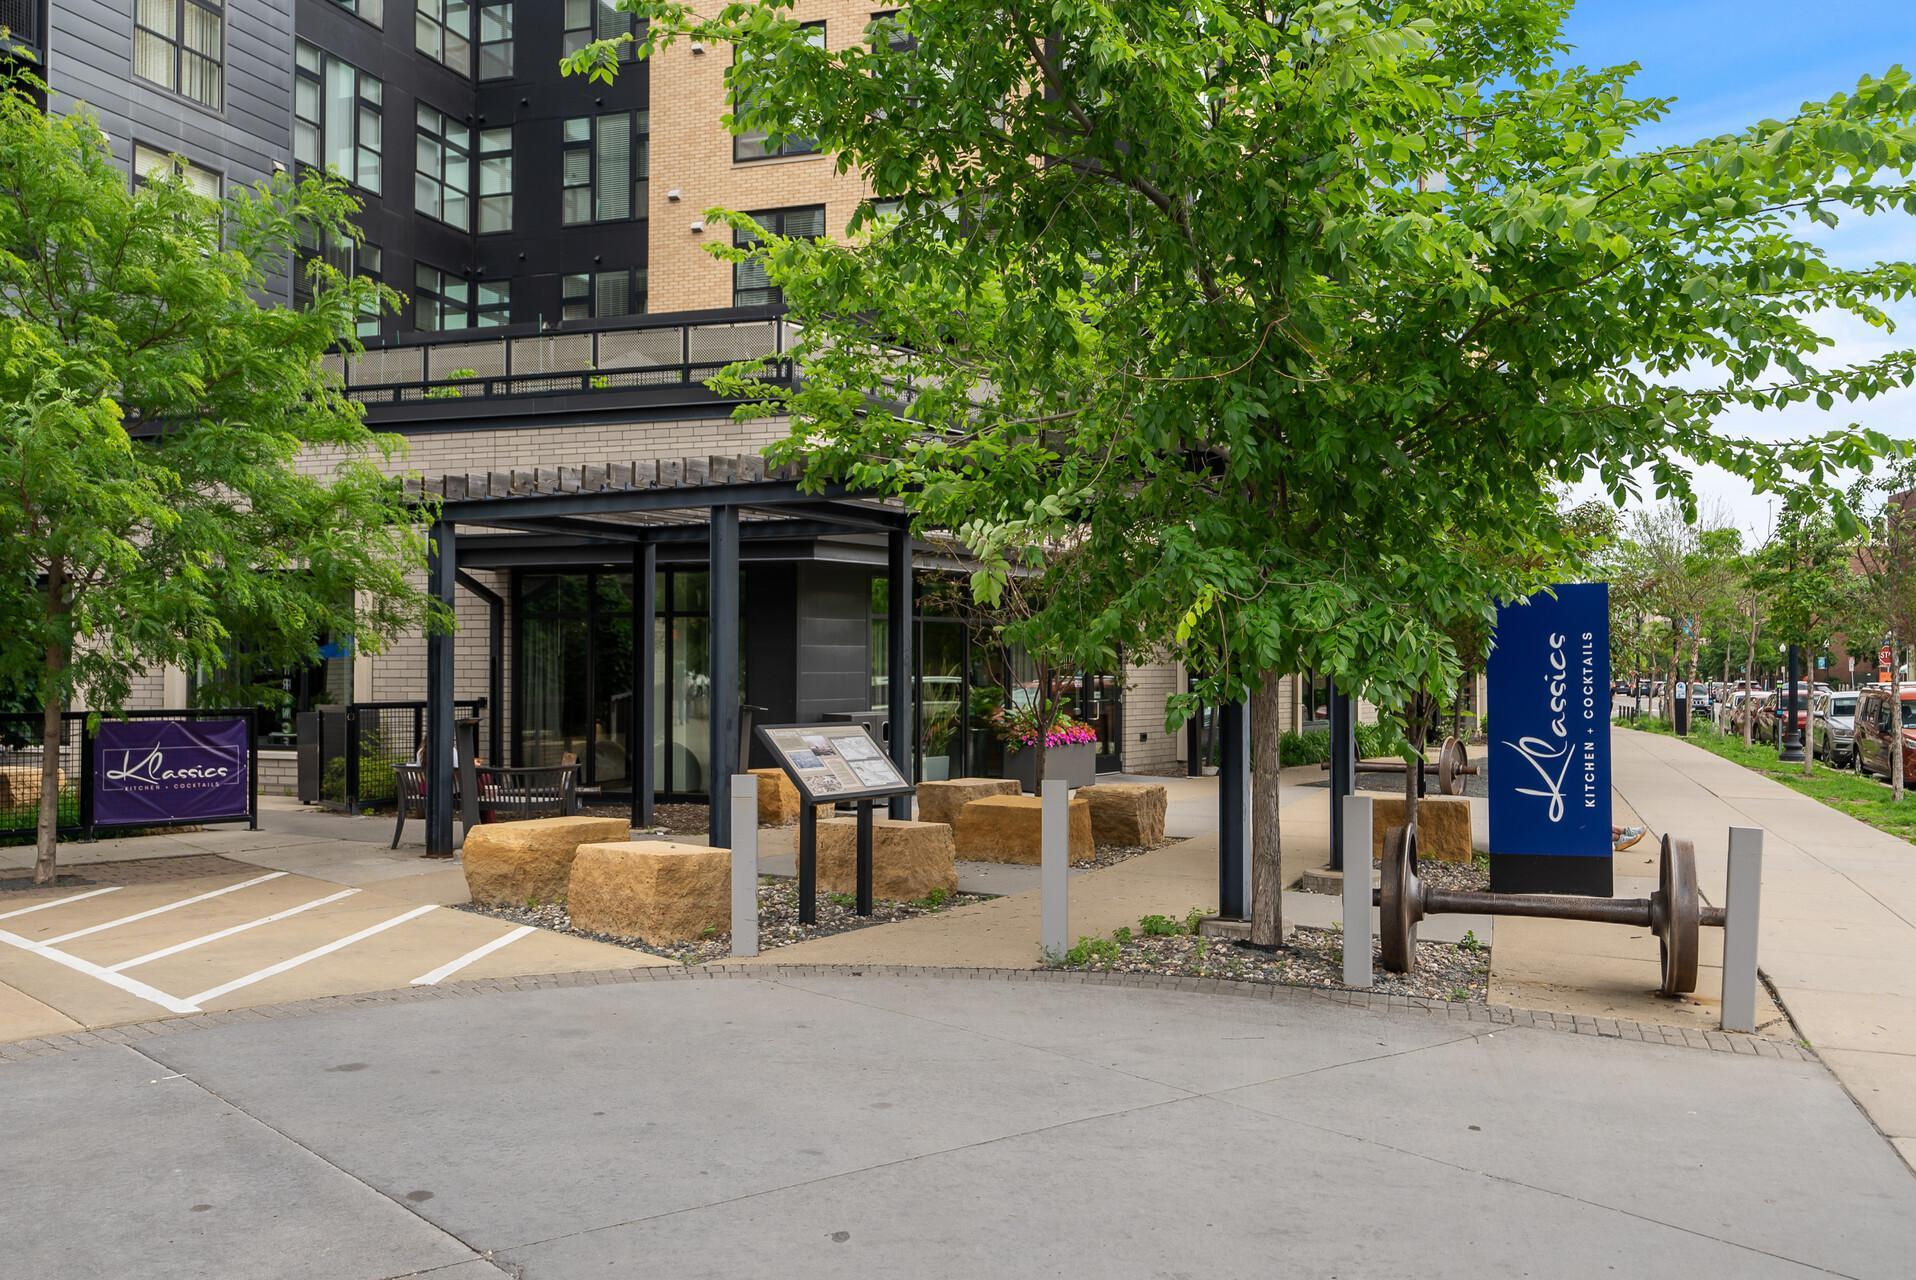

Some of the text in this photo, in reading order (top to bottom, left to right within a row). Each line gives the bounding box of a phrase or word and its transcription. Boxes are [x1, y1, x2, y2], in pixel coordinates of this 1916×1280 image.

[1582, 631, 1594, 720] COCKTAILS
[1501, 632, 1576, 822] Klassics
[106, 741, 229, 785] Klassics
[173, 781, 220, 790] COCKTAILS
[1584, 741, 1596, 808] KITCHEN
